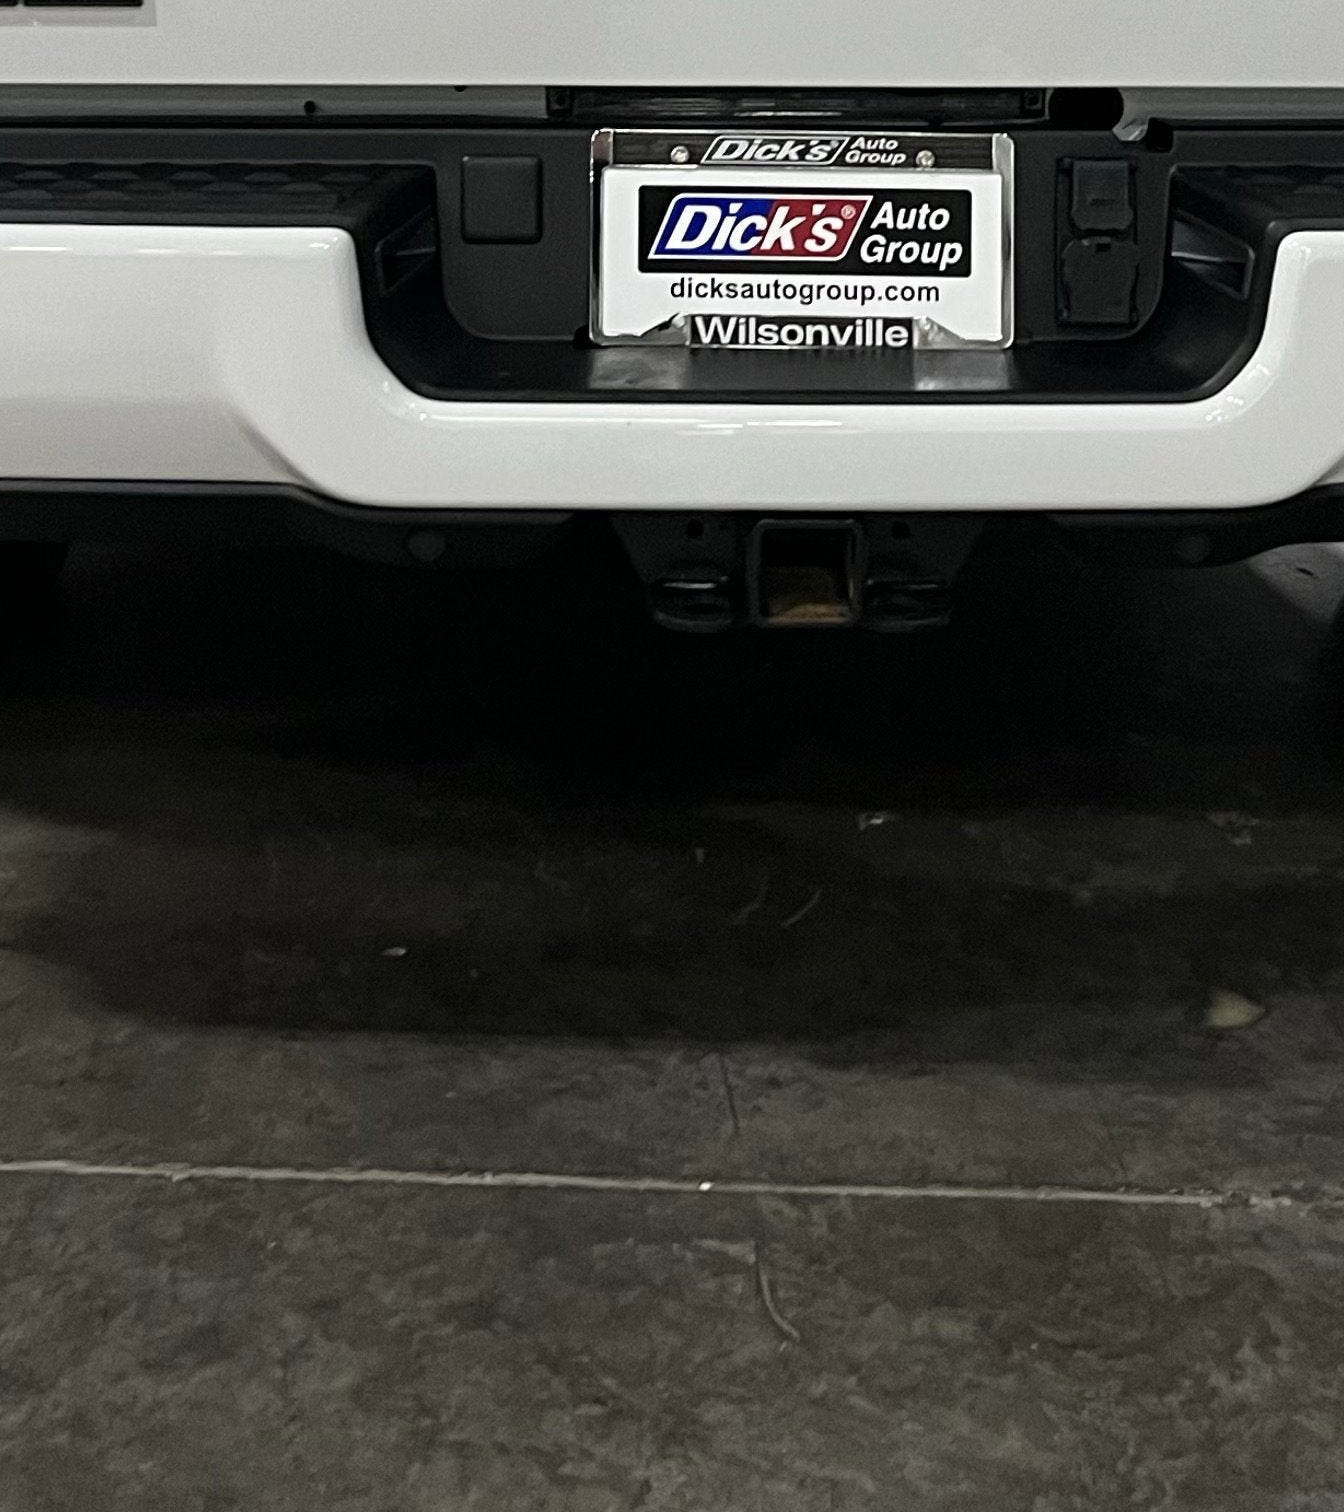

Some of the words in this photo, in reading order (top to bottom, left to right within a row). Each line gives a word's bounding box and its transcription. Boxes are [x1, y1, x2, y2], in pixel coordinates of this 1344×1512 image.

[711, 139, 833, 161] Dick's
[850, 137, 898, 151] Auto
[845, 150, 906, 166] Group
[664, 202, 843, 251] Dick's
[870, 202, 950, 230] Auto
[860, 239, 963, 270] Group
[670, 277, 940, 305] dicksautogroup.com
[695, 316, 909, 347] Wilsonville
